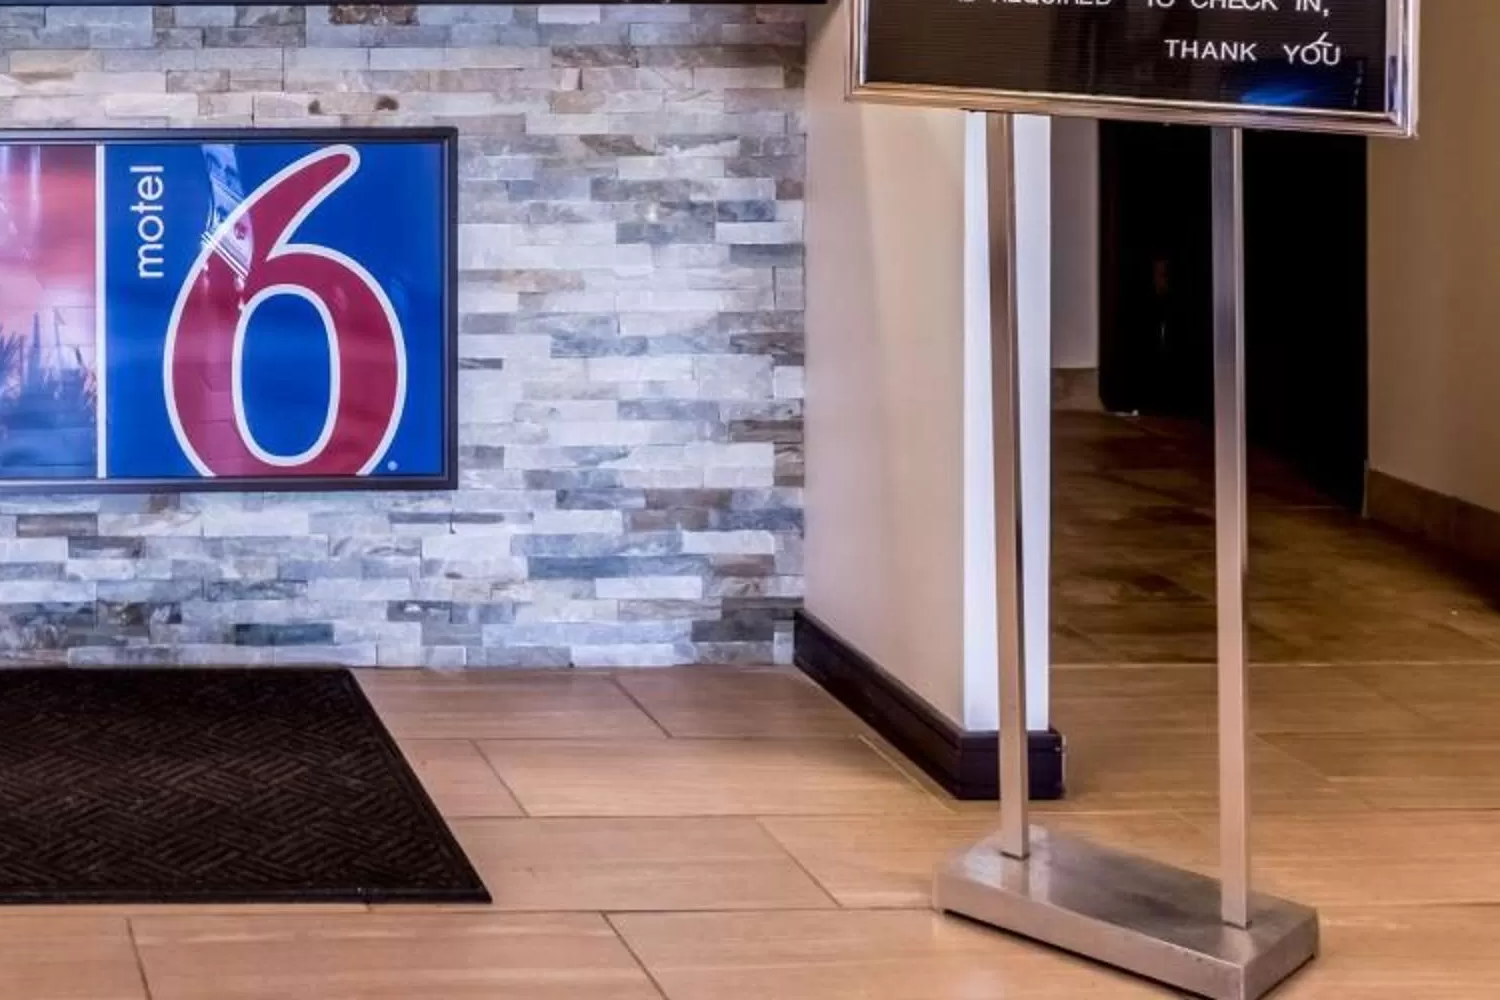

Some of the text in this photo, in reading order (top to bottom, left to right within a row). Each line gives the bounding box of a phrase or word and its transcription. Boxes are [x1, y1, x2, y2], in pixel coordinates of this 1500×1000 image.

[1164, 39, 1341, 66] THANK YOU
[130, 144, 407, 476] motel 6
